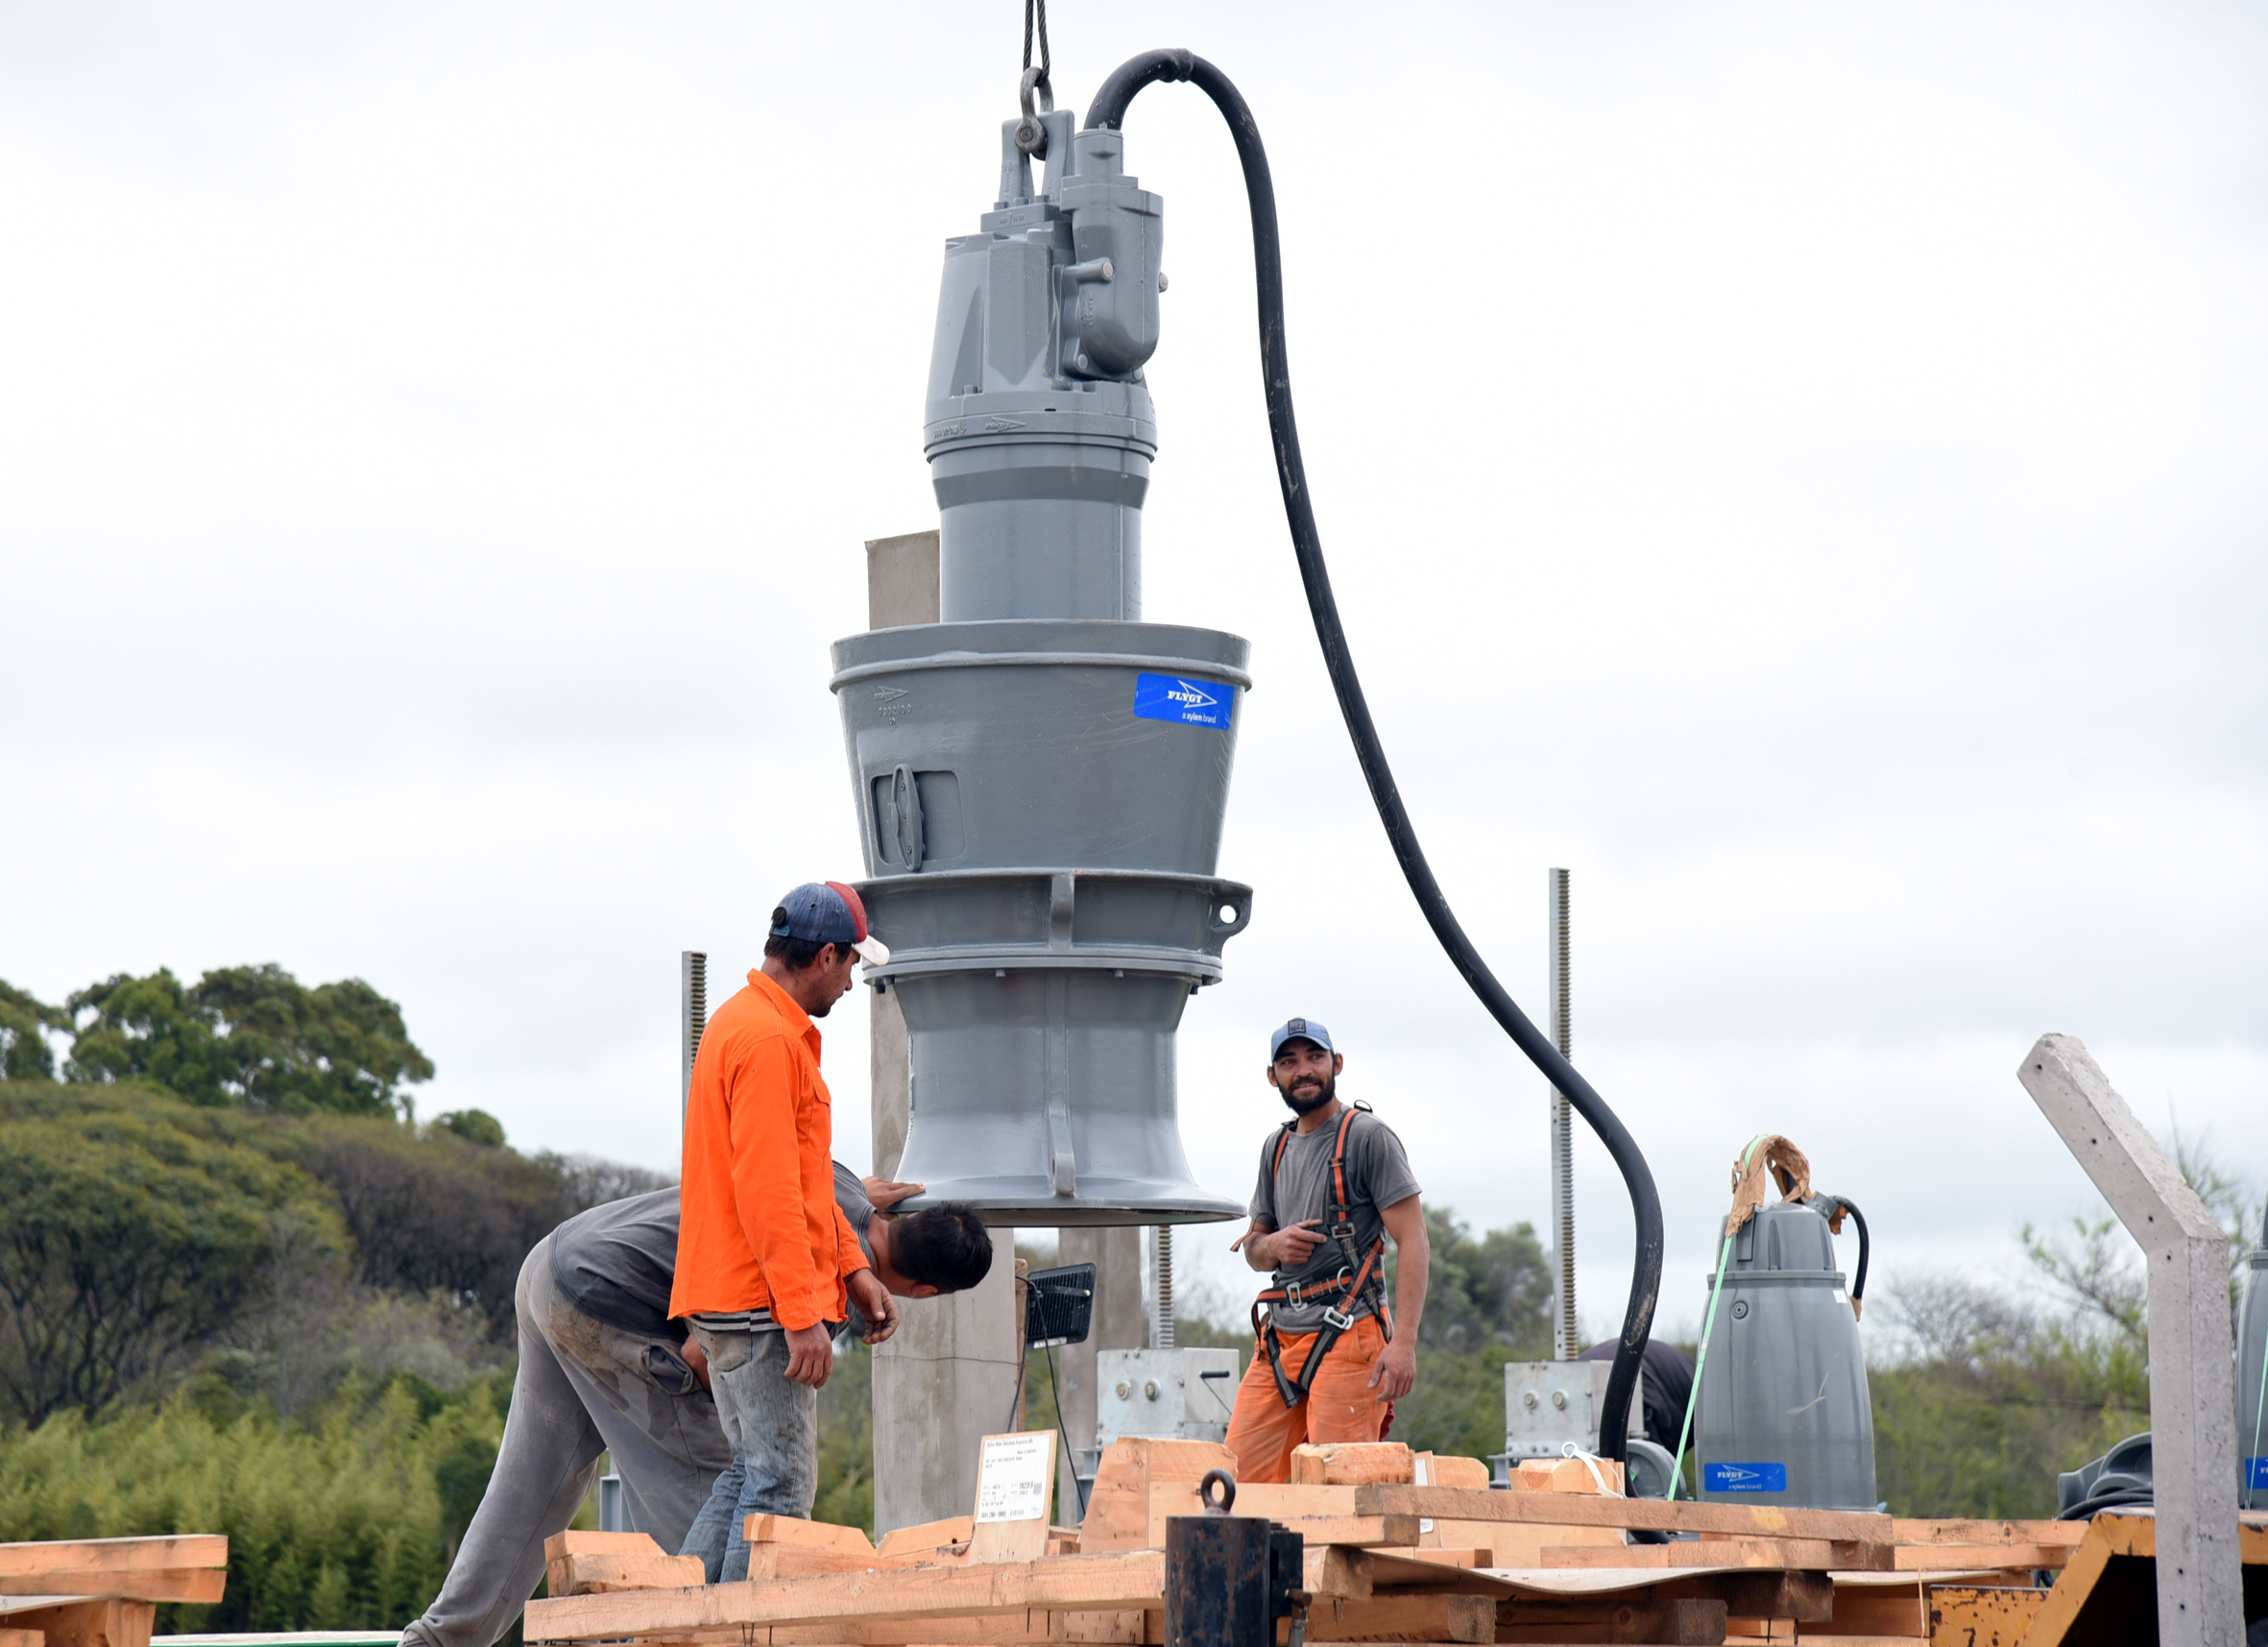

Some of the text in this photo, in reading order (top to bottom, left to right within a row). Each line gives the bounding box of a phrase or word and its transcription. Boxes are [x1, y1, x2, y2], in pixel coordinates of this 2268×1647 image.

[1168, 690, 1202, 703] FLYGT
[1187, 712, 1202, 722] xylem
[1203, 713, 1217, 724] brand
